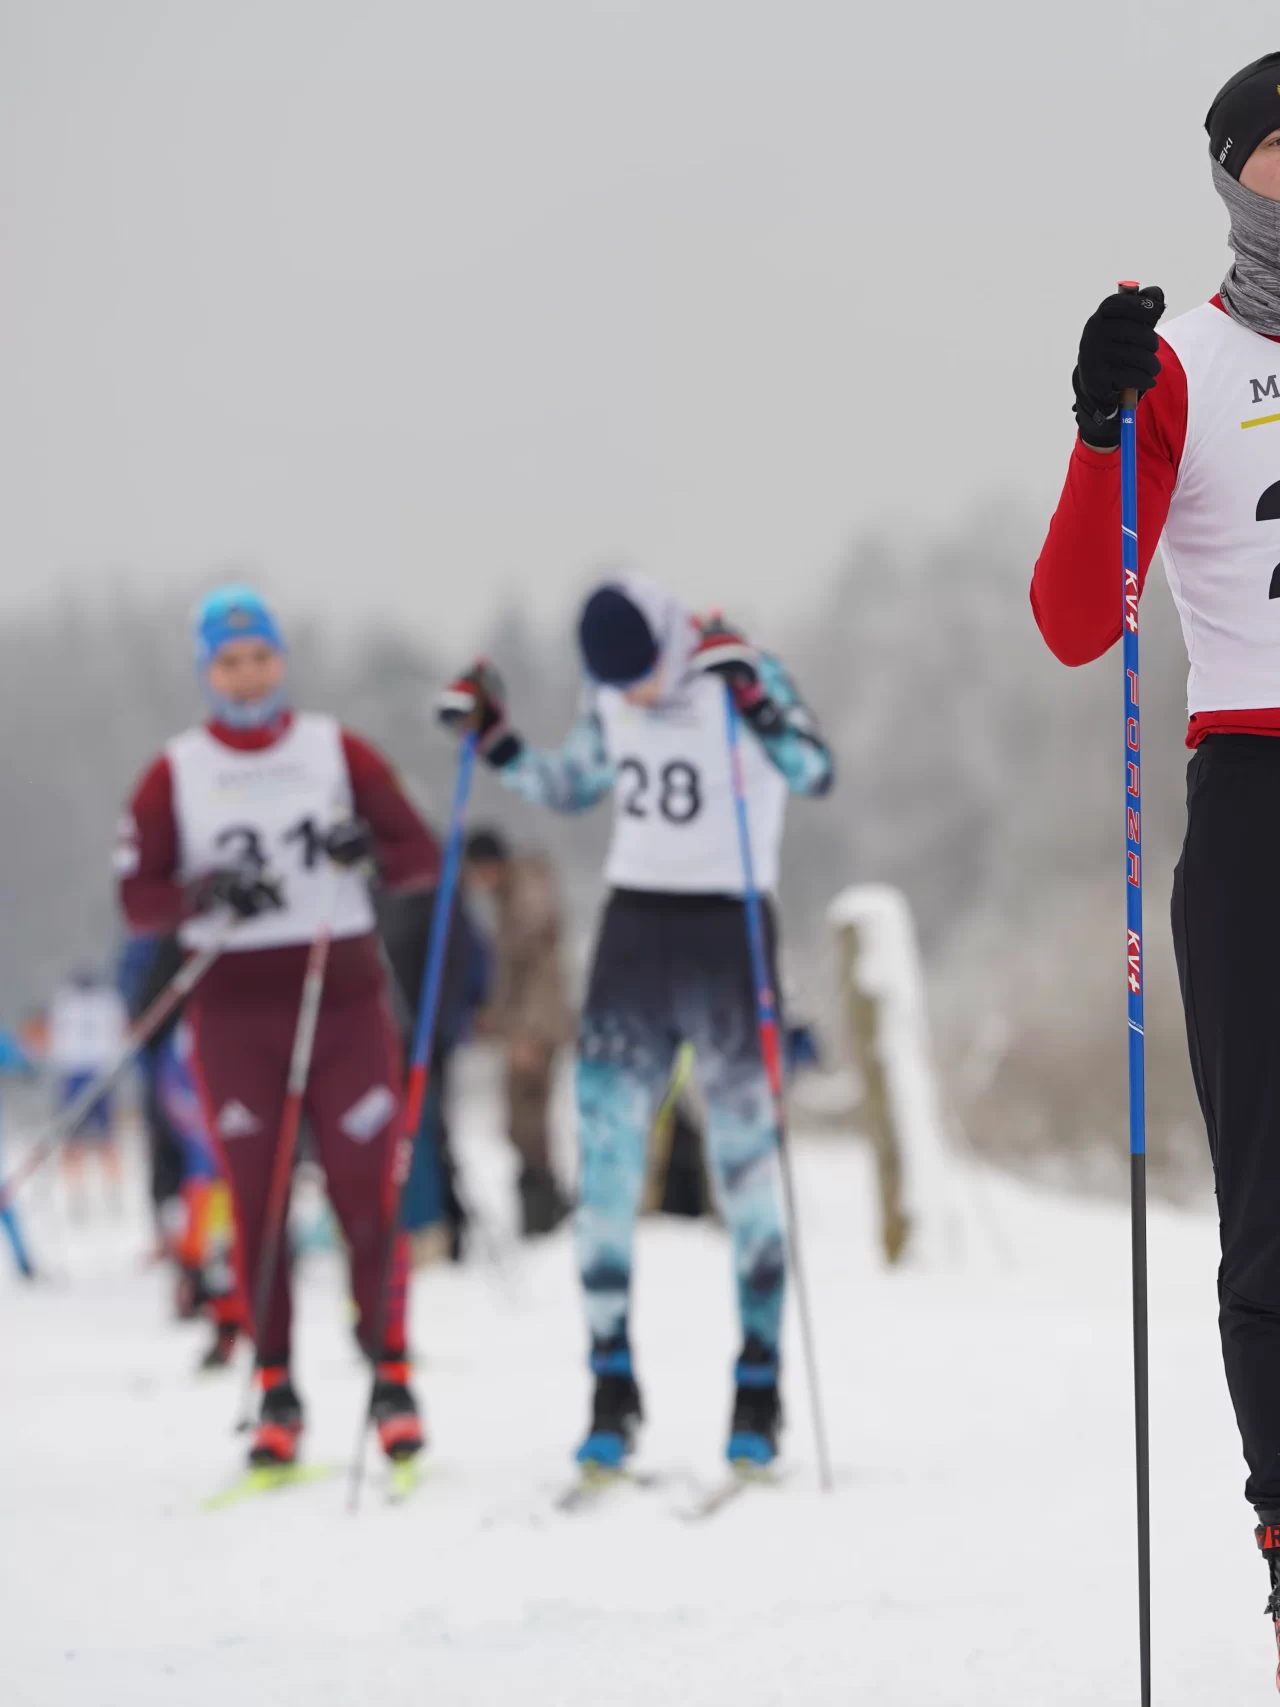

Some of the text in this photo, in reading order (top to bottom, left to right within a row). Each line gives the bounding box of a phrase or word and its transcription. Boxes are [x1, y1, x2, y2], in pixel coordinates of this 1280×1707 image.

[1218, 137, 1234, 165] SKI
[615, 754, 703, 826] 28
[1126, 668, 1140, 889] FORZA
